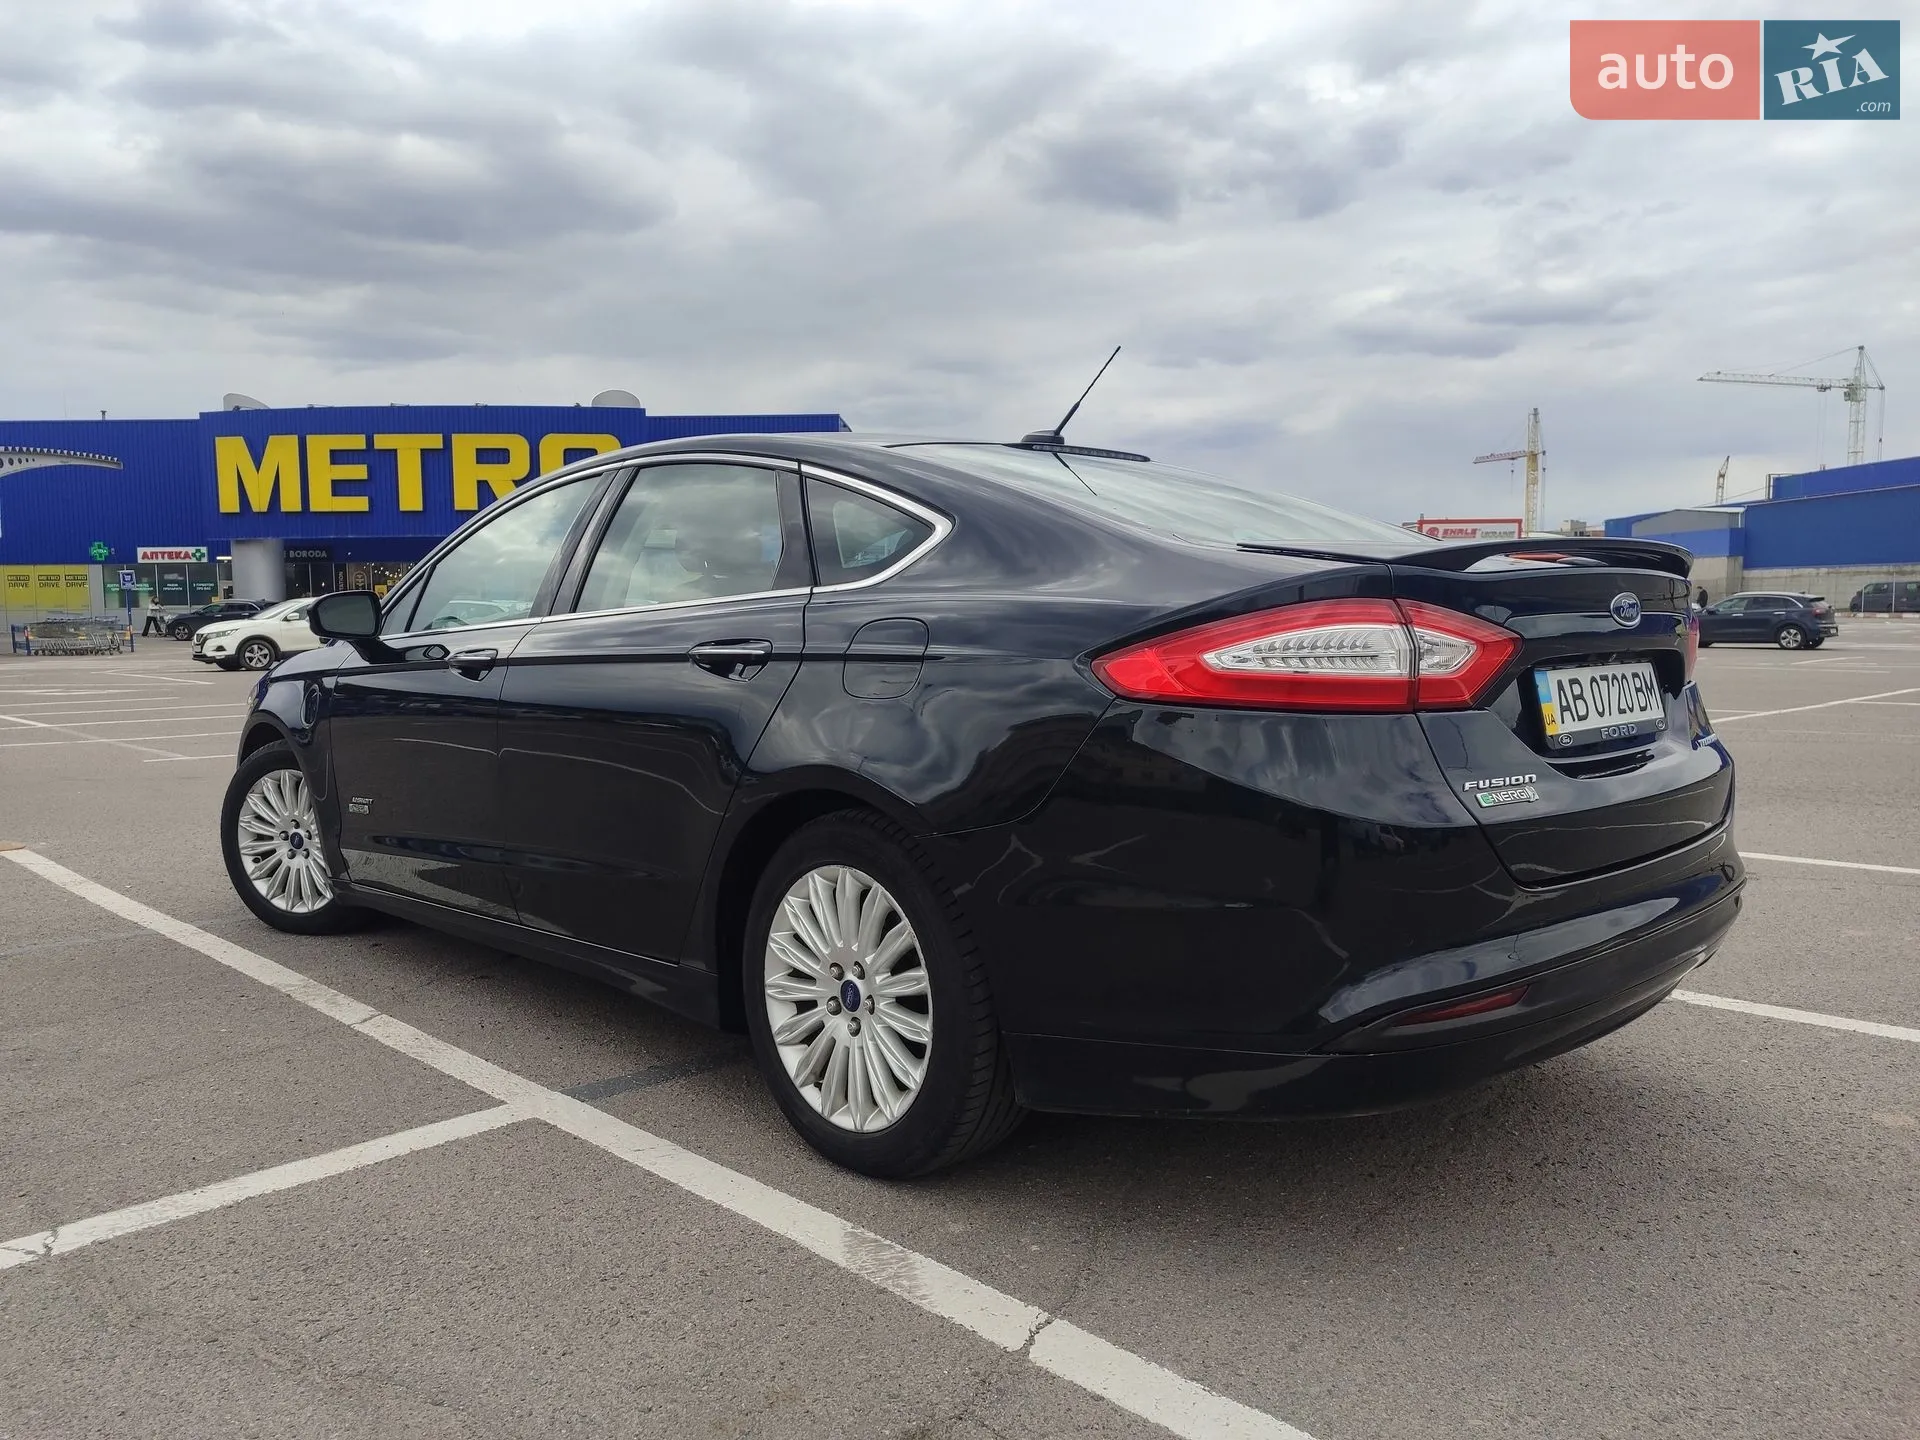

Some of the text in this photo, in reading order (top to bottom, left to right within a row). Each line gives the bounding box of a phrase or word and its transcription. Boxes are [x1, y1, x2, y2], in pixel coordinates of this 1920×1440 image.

[141, 550, 192, 560] АПТЕКА
[289, 550, 328, 559] BORODA
[1557, 671, 1660, 724] AB 0720 BM
[1545, 714, 1556, 726] UA
[1600, 724, 1638, 739] FORD
[1464, 774, 1537, 791] FUSION
